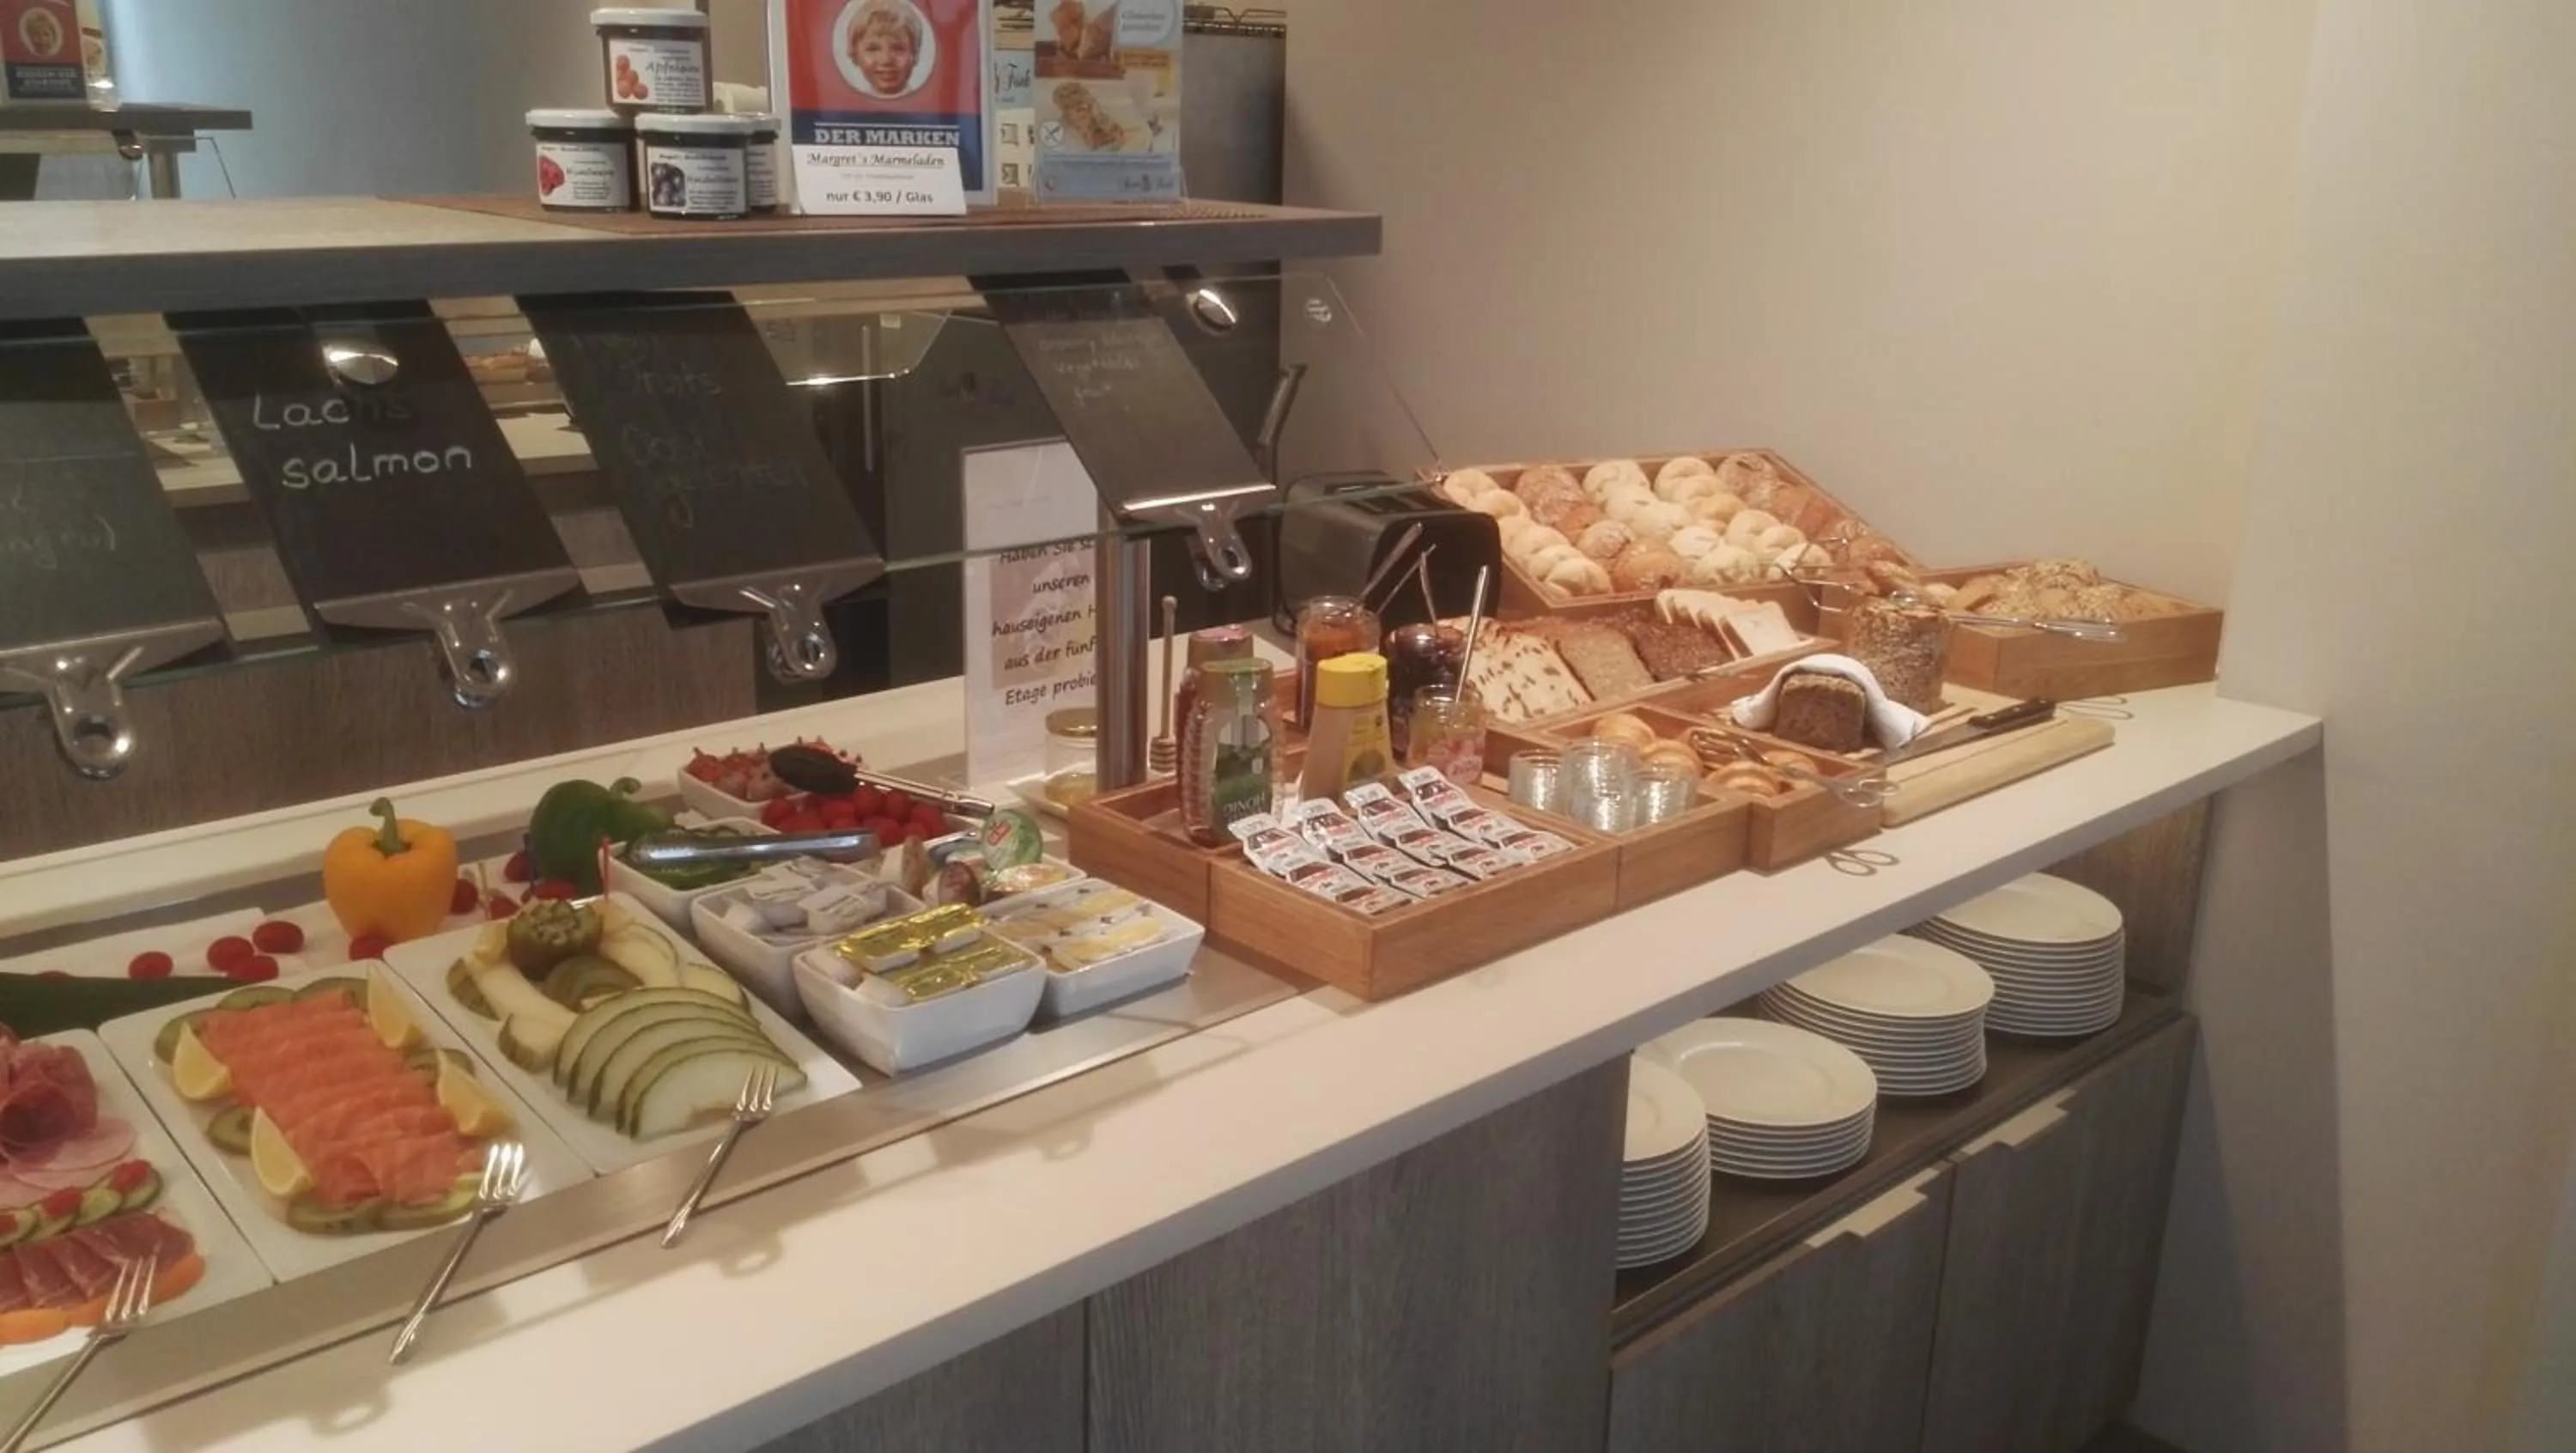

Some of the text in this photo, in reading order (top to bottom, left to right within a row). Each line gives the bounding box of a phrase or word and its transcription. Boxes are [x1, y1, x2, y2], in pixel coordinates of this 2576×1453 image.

[814, 129, 961, 147] DER MARKEN
[825, 192, 849, 203] nur
[864, 191, 892, 204] 3,90
[906, 192, 934, 203] Glas
[281, 439, 473, 490] salmon
[1032, 575, 1090, 593] unseren
[993, 609, 1082, 635] hauseigenen
[1005, 654, 1030, 671] aus
[1034, 646, 1062, 665] der
[1005, 671, 1097, 705] Etage probie
